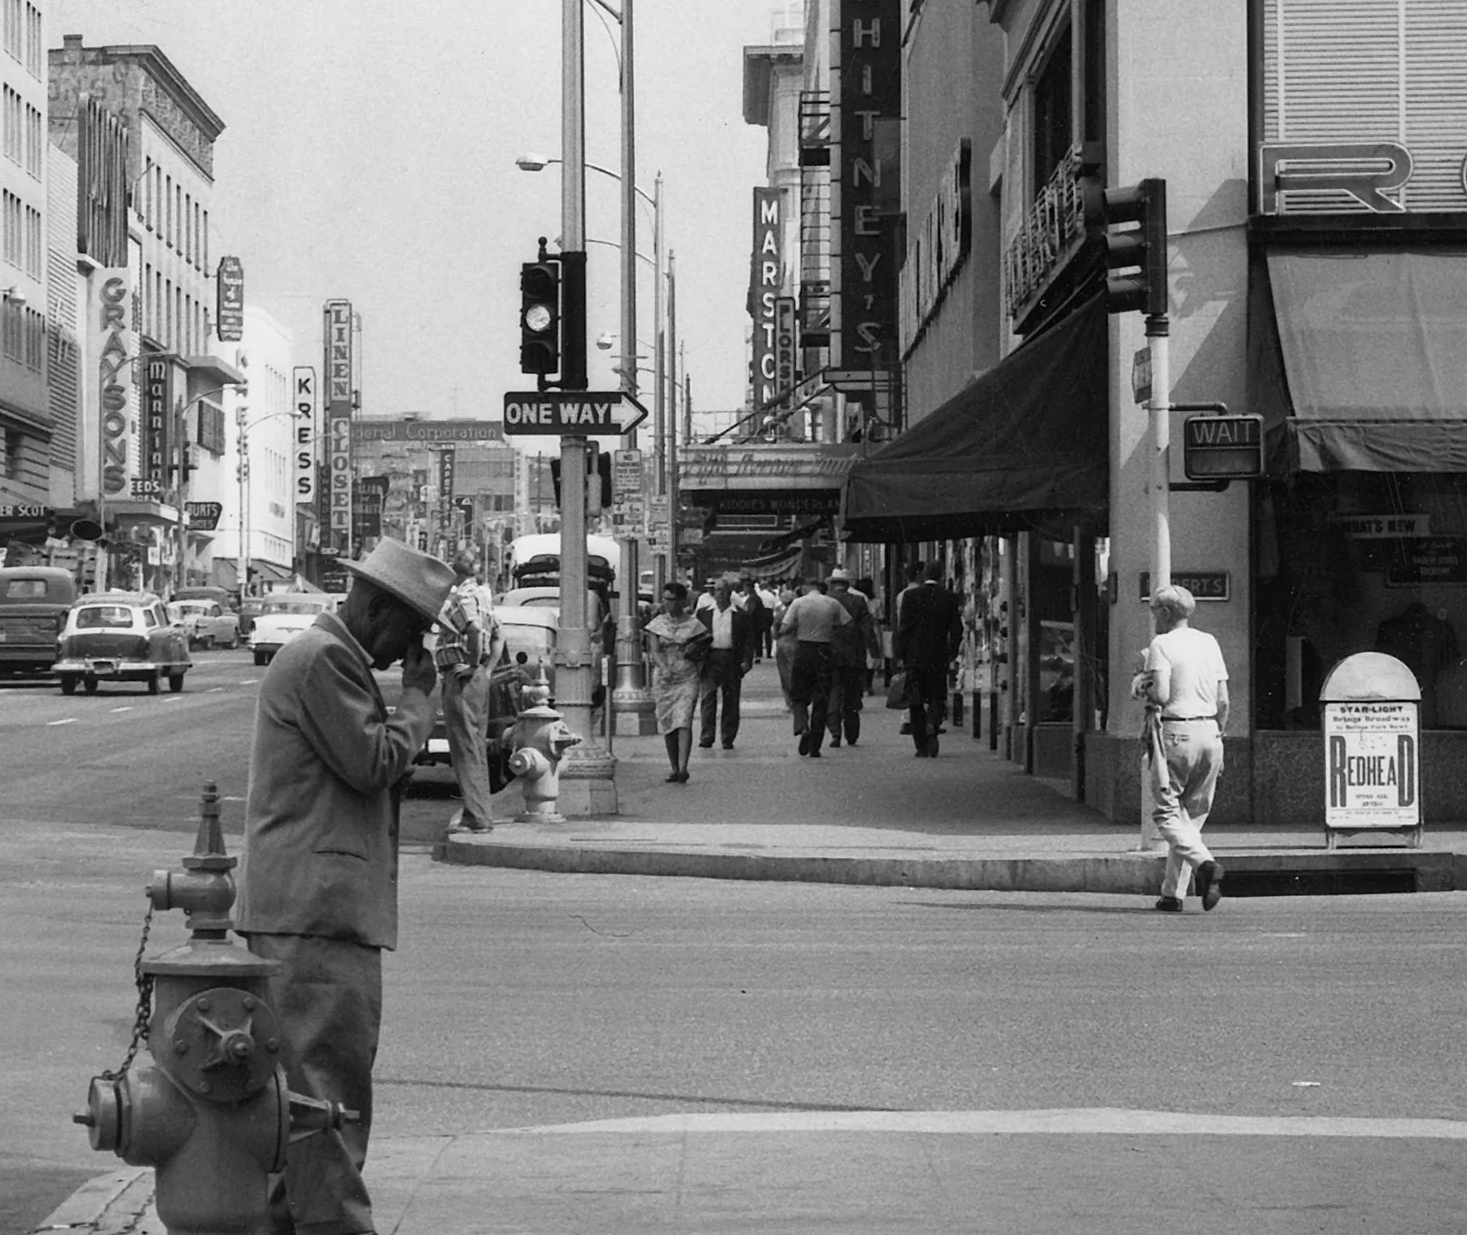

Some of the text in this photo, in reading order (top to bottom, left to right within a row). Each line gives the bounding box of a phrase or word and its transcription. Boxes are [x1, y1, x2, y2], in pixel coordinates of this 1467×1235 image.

[333, 309, 349, 526] LINEN CLOSET
[505, 402, 610, 424] ONE WAY
[297, 377, 312, 494] KRESS
[351, 423, 497, 443] perial Corporation
[1192, 420, 1255, 444] WAIT
[130, 479, 160, 493] EEDS
[17, 505, 47, 517] SCOT
[770, 497, 840, 511] WONDERLAN
[1340, 706, 1404, 714] STAR-LIGHT
[1329, 734, 1415, 808] REDHEAD
